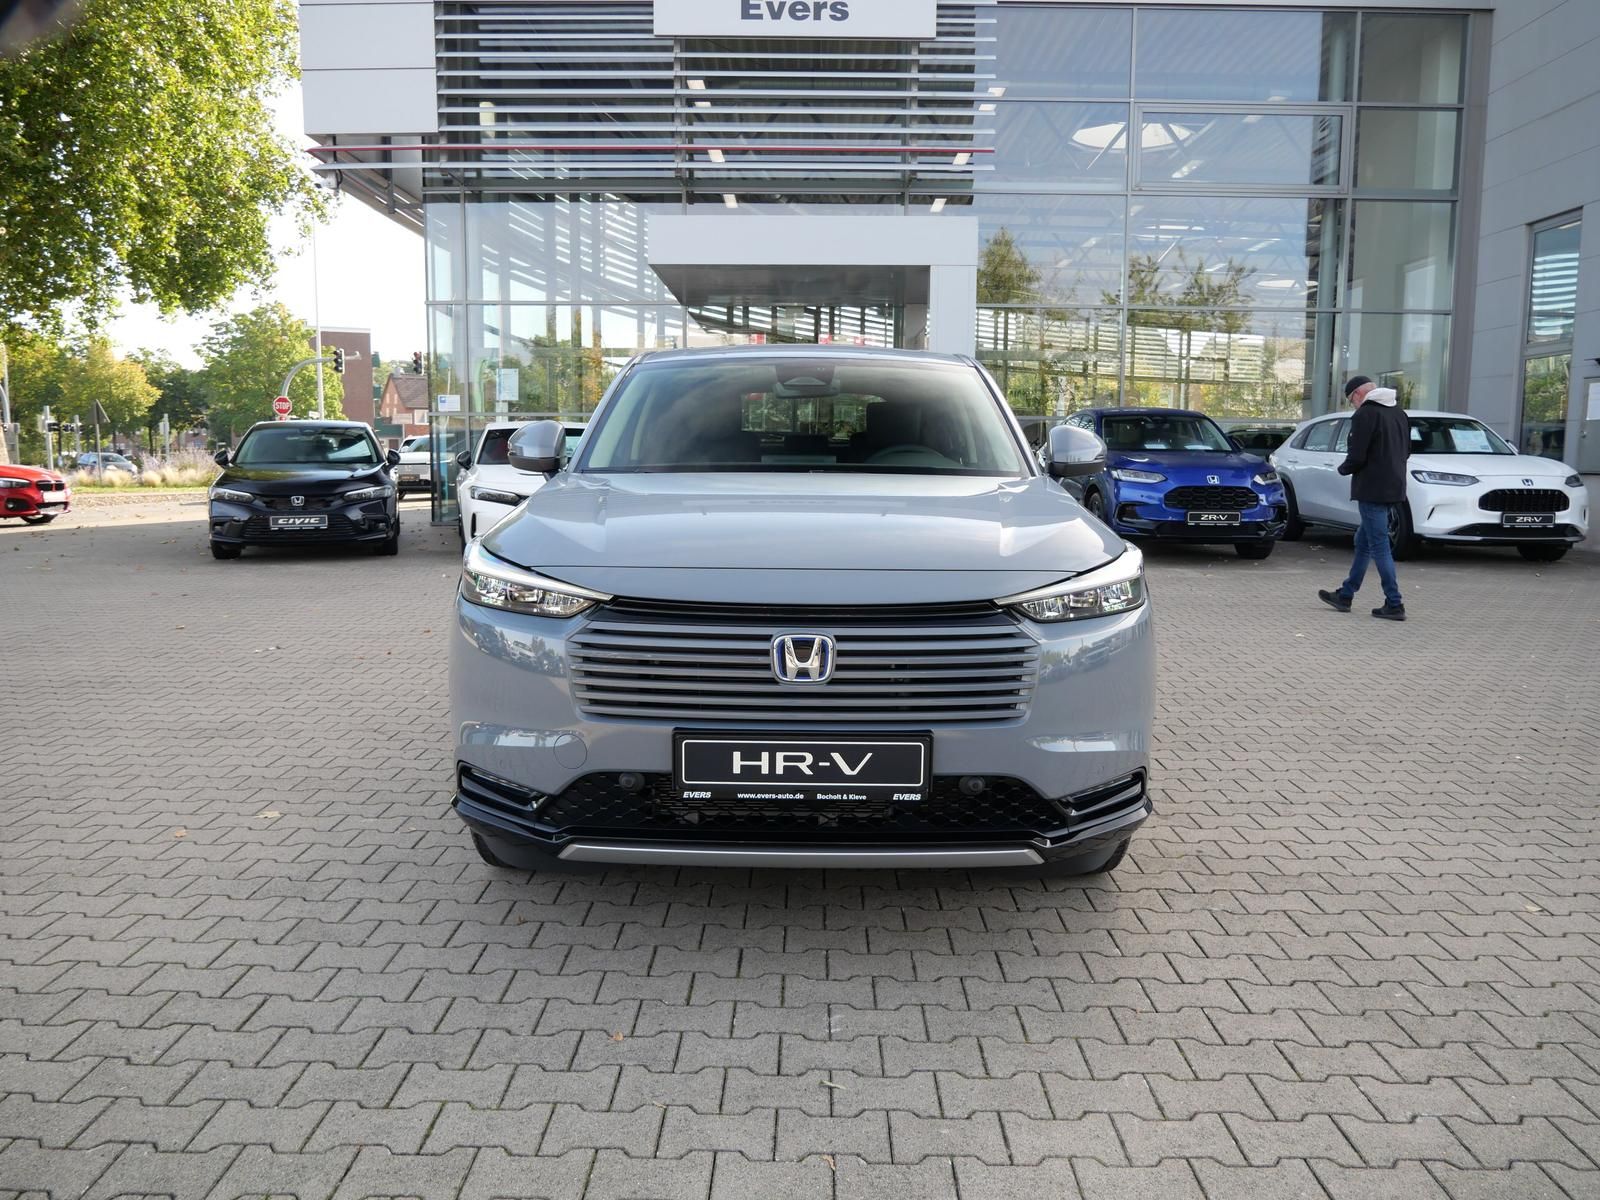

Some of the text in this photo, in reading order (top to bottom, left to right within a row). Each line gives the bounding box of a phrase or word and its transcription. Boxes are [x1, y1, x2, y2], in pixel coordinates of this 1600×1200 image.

[741, 0, 849, 21] Evers
[275, 401, 290, 410] STOP
[732, 751, 873, 776] HR-V
[682, 791, 712, 799] EVERS
[737, 792, 804, 800] www.evers-auto.de
[892, 793, 922, 801] EVERS
